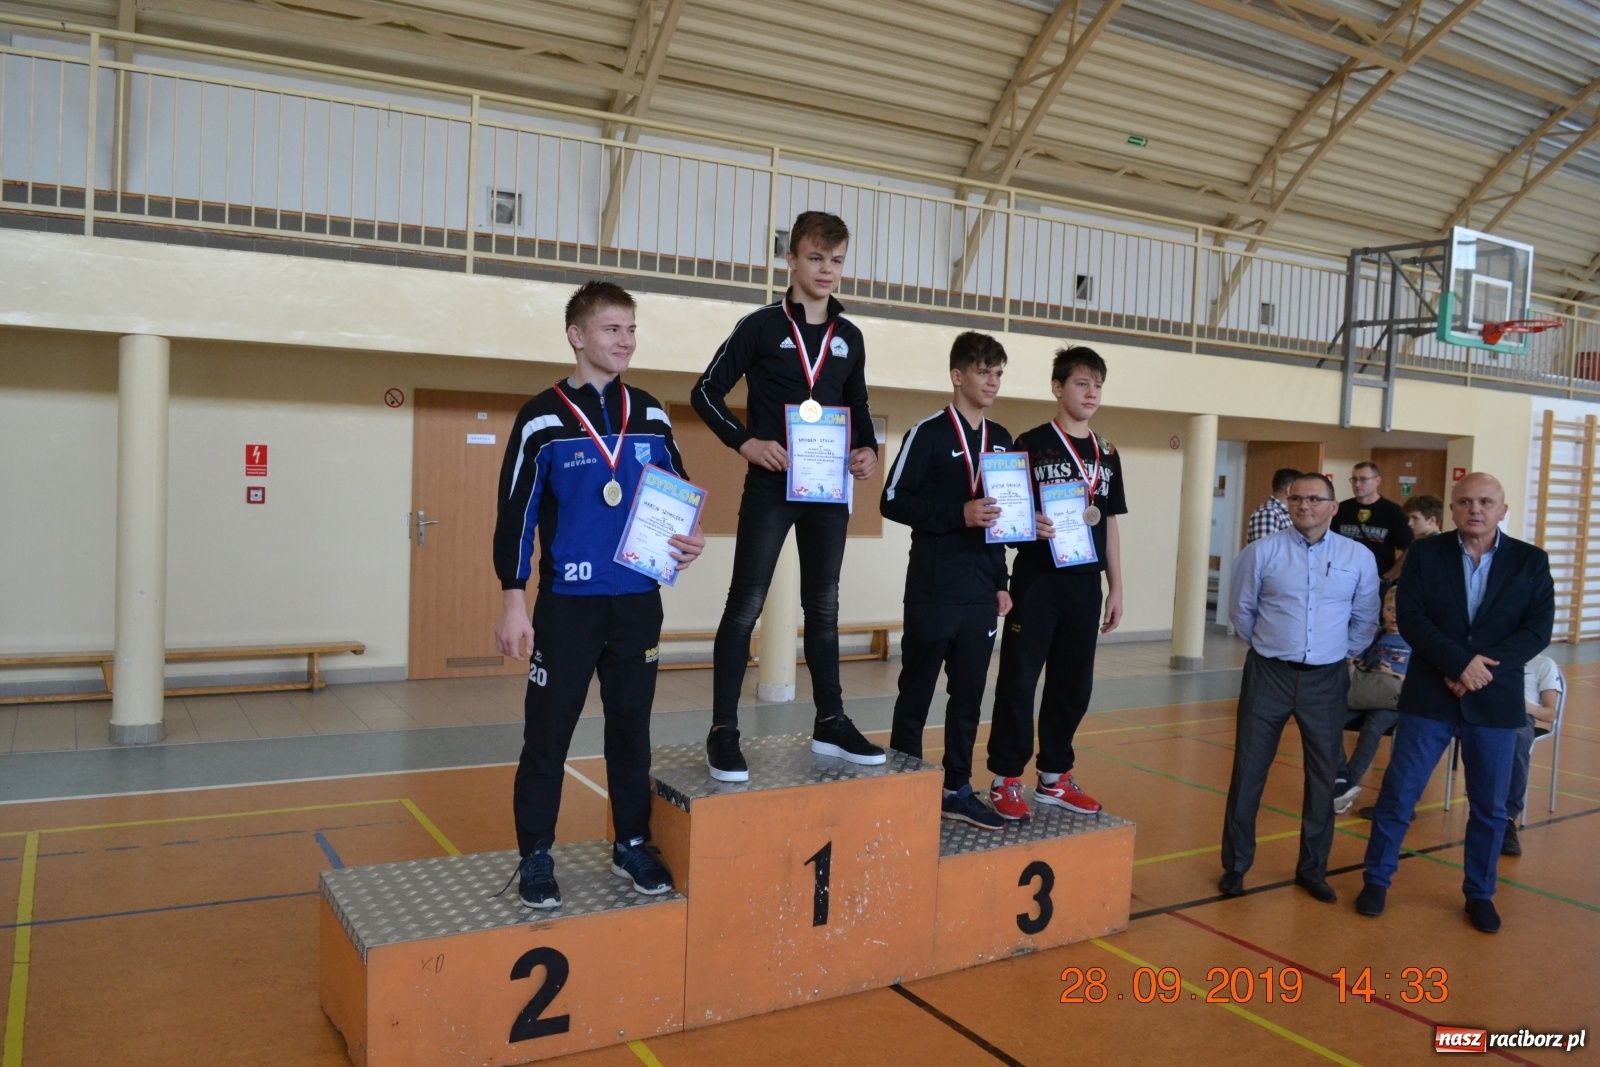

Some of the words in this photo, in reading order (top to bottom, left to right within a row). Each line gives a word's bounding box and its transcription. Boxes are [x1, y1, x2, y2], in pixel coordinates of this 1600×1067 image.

[791, 412, 846, 425] DOM
[564, 458, 597, 469] MEVAGO
[984, 457, 1026, 470] DYPLOM
[1033, 462, 1072, 481] WKS
[645, 472, 701, 507] DYPLOM
[1043, 486, 1085, 501] DYPLOM
[564, 561, 592, 581] 20
[528, 662, 548, 687] 20
[803, 841, 832, 927] 1
[1016, 860, 1055, 935] 3
[509, 946, 570, 1044] 2
